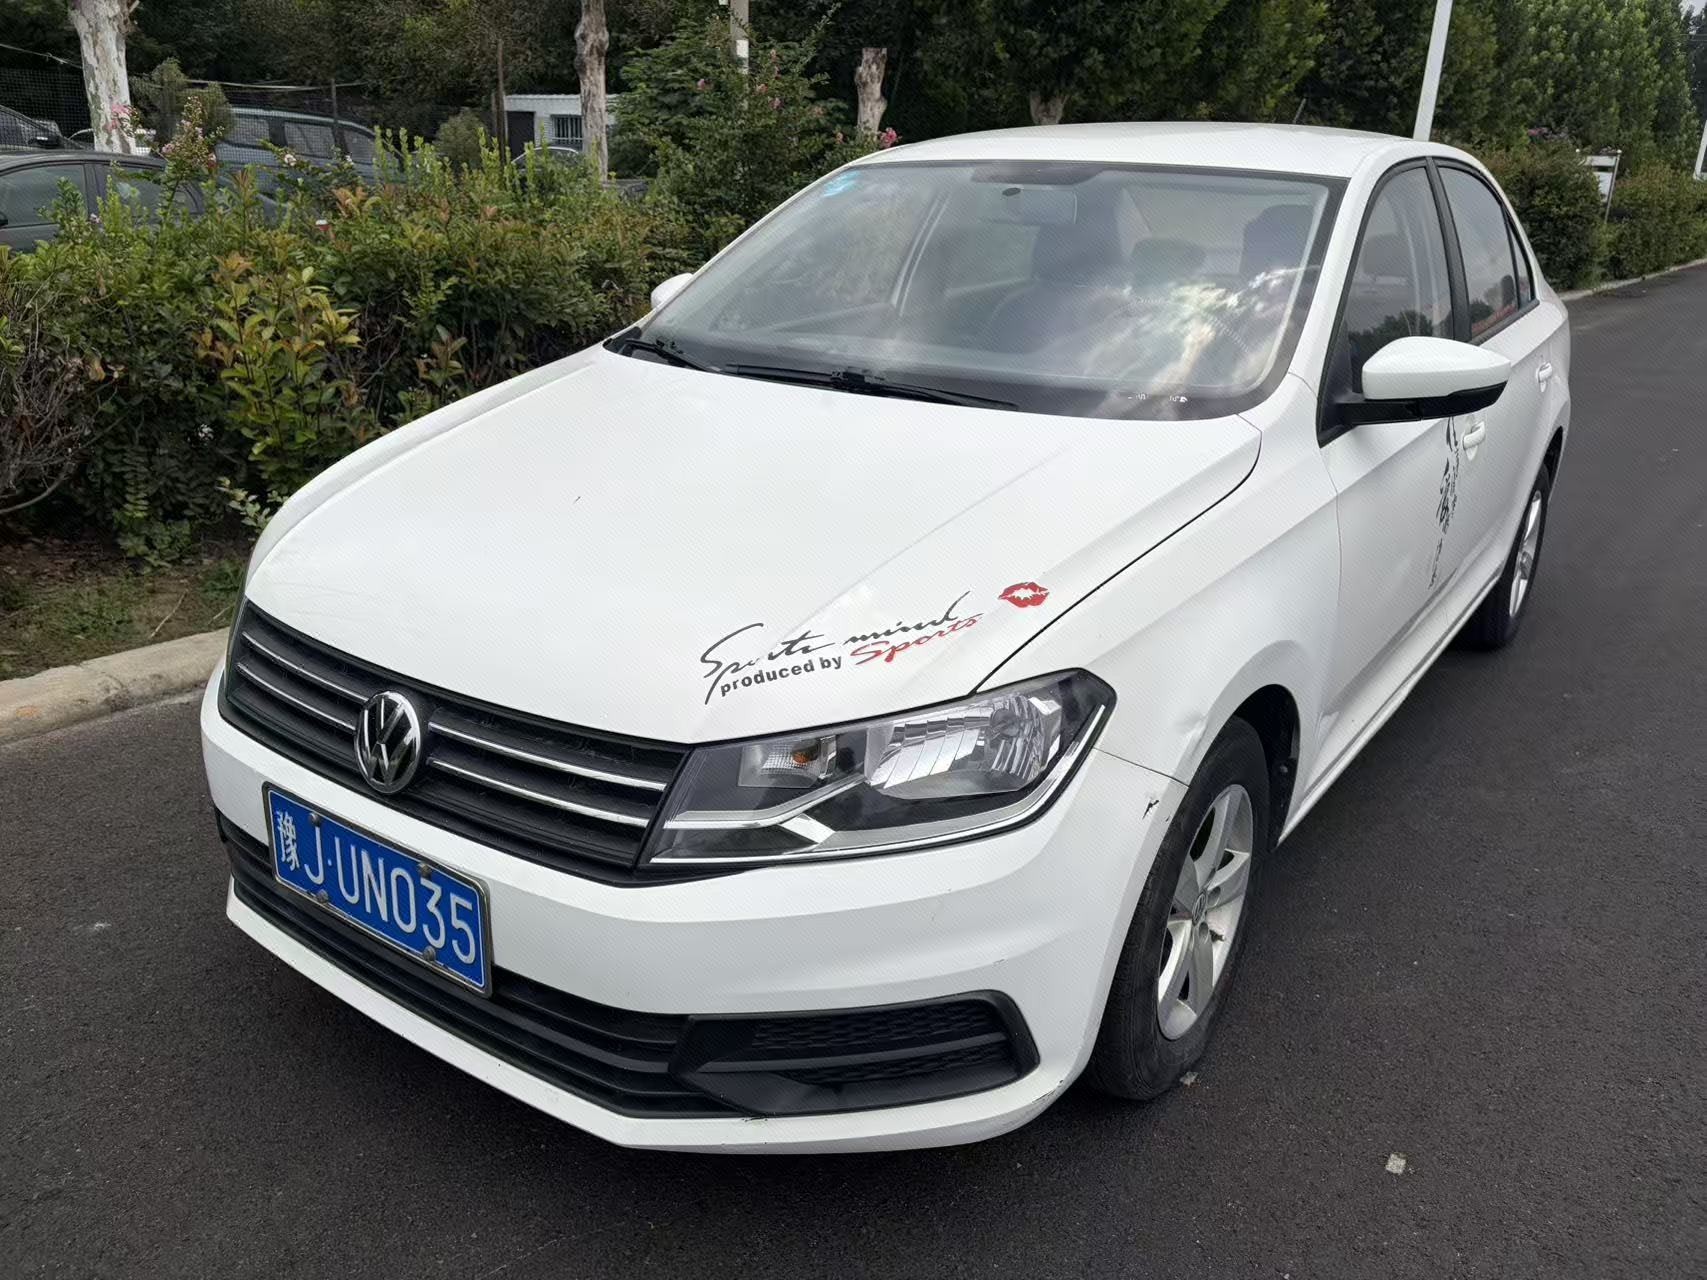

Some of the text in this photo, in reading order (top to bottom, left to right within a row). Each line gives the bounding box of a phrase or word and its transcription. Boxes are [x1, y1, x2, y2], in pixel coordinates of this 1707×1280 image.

[843, 590, 971, 646] mind
[720, 612, 985, 697] produced by Sports
